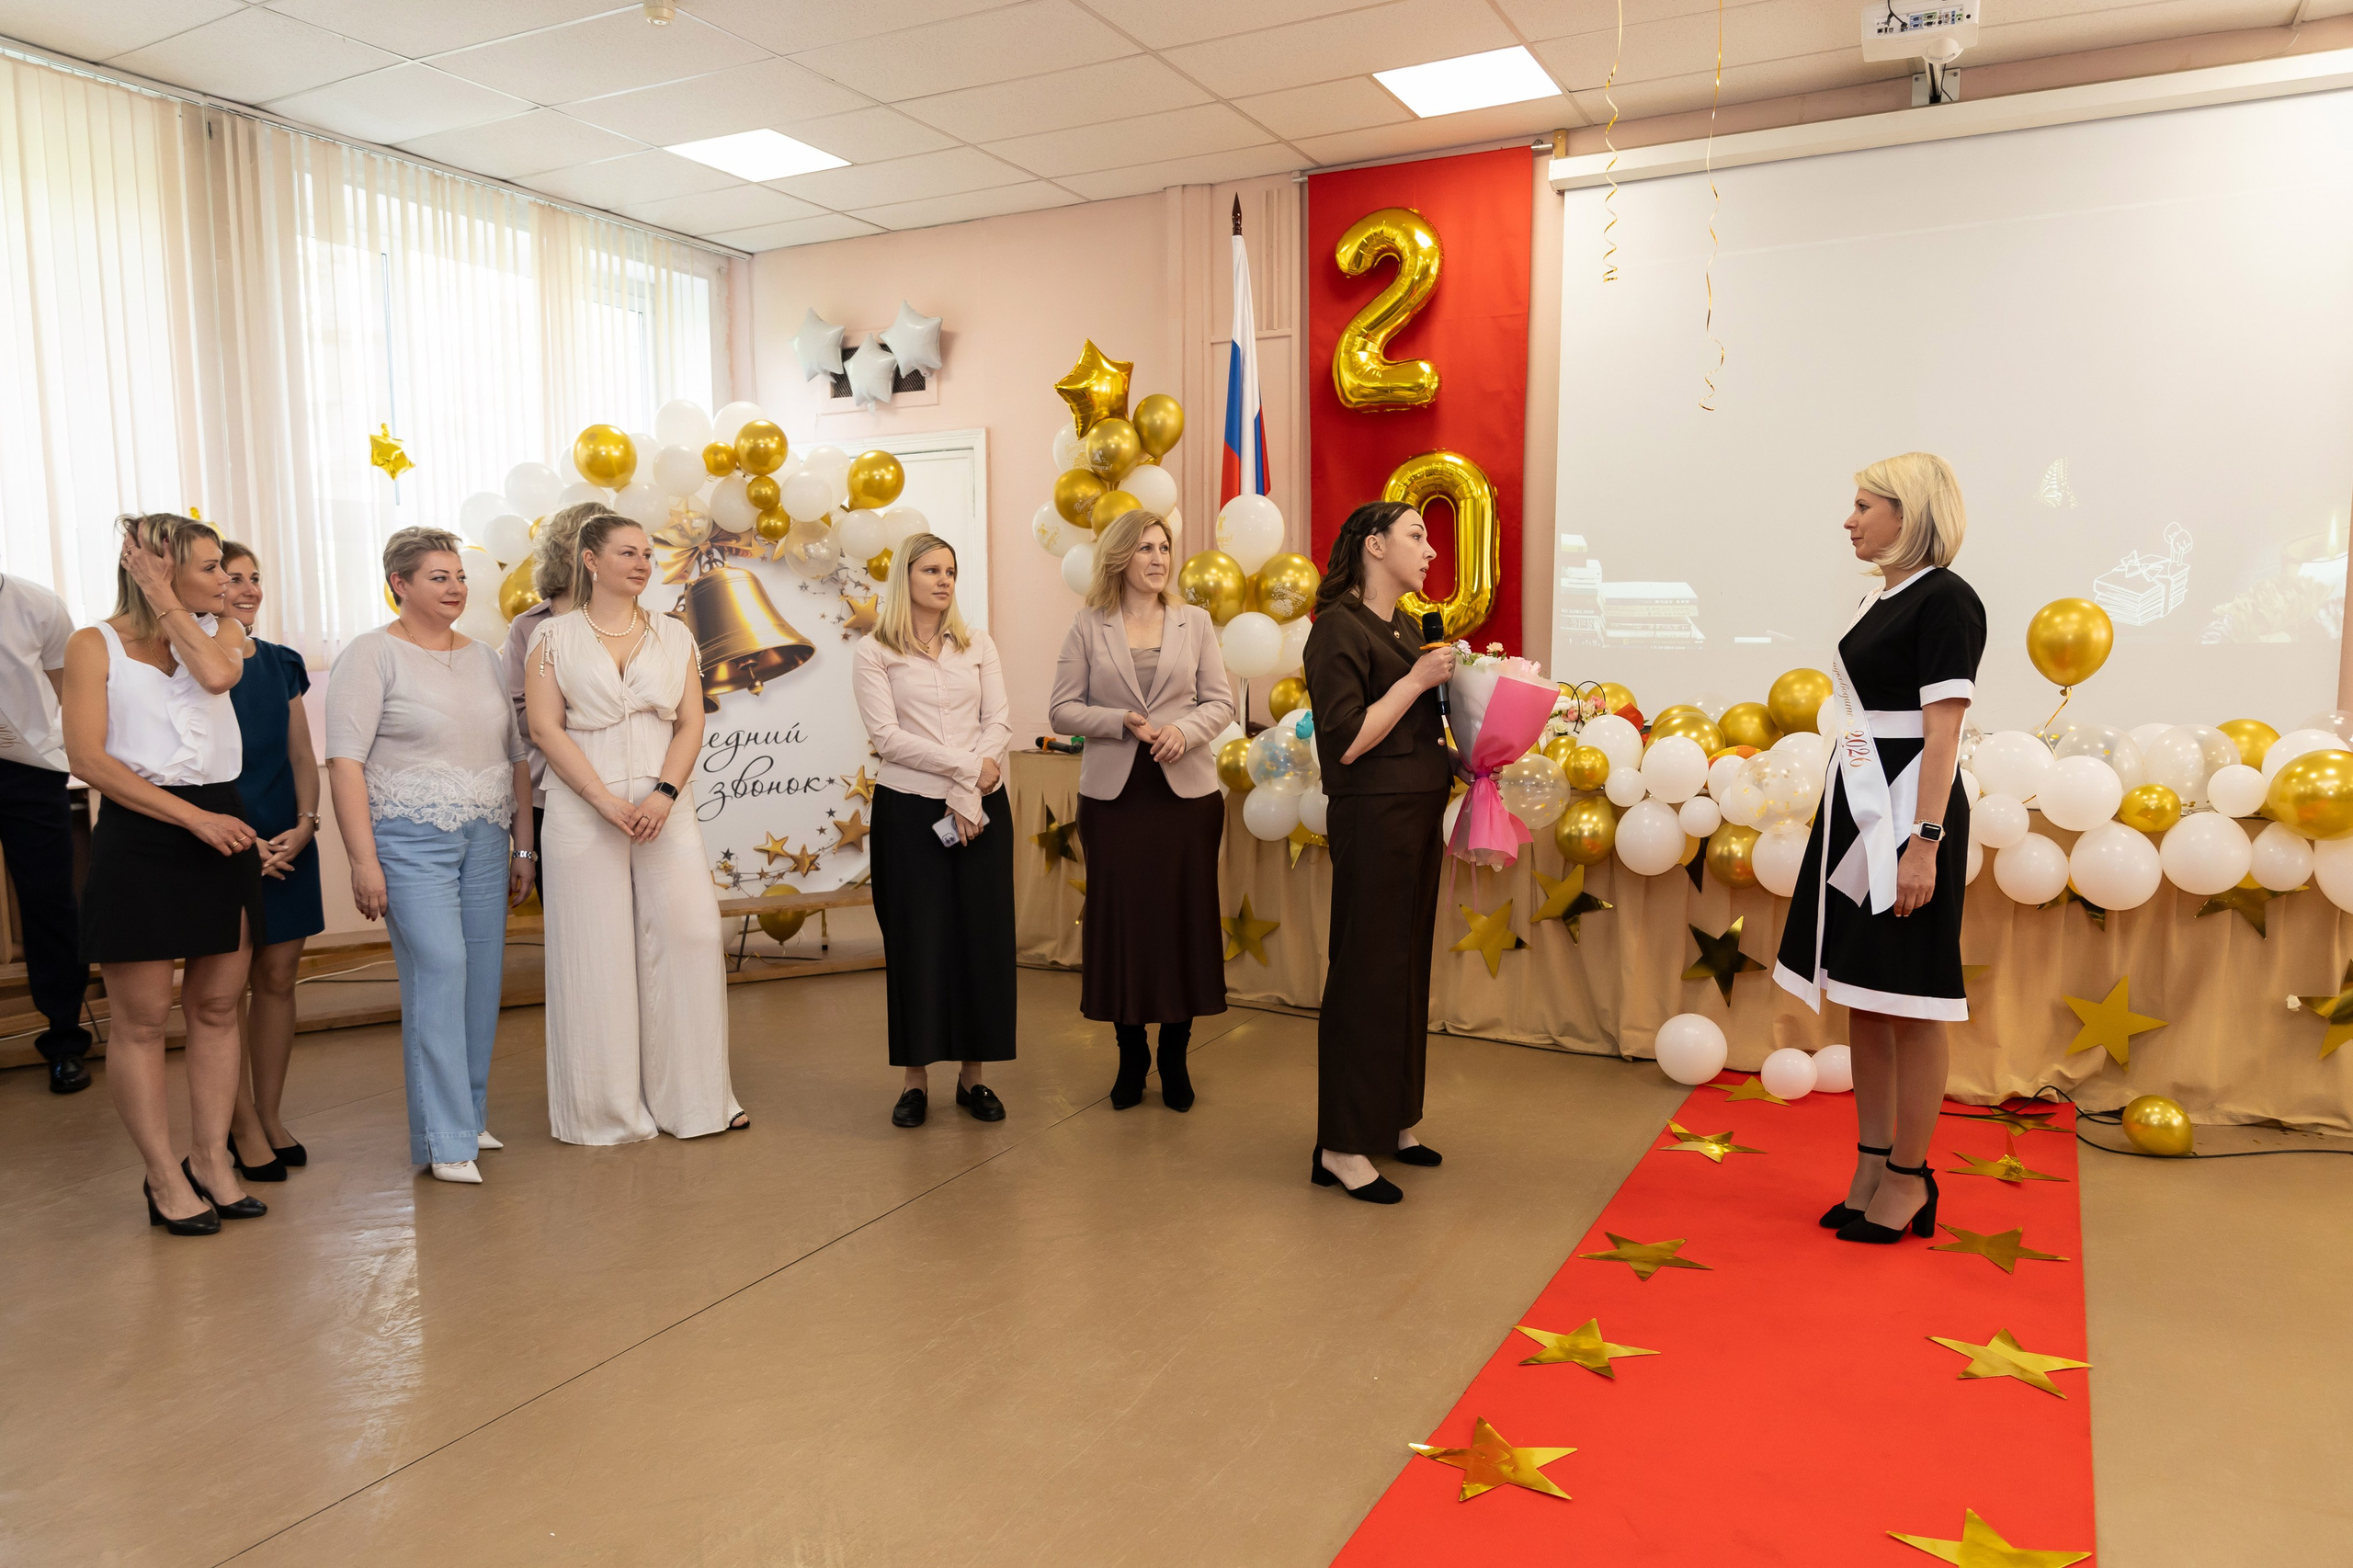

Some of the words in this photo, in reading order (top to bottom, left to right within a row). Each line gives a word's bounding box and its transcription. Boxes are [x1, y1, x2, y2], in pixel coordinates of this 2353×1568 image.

[700, 722, 809, 773] едний
[1845, 730, 1872, 768] 2026
[695, 755, 829, 823] звонок
